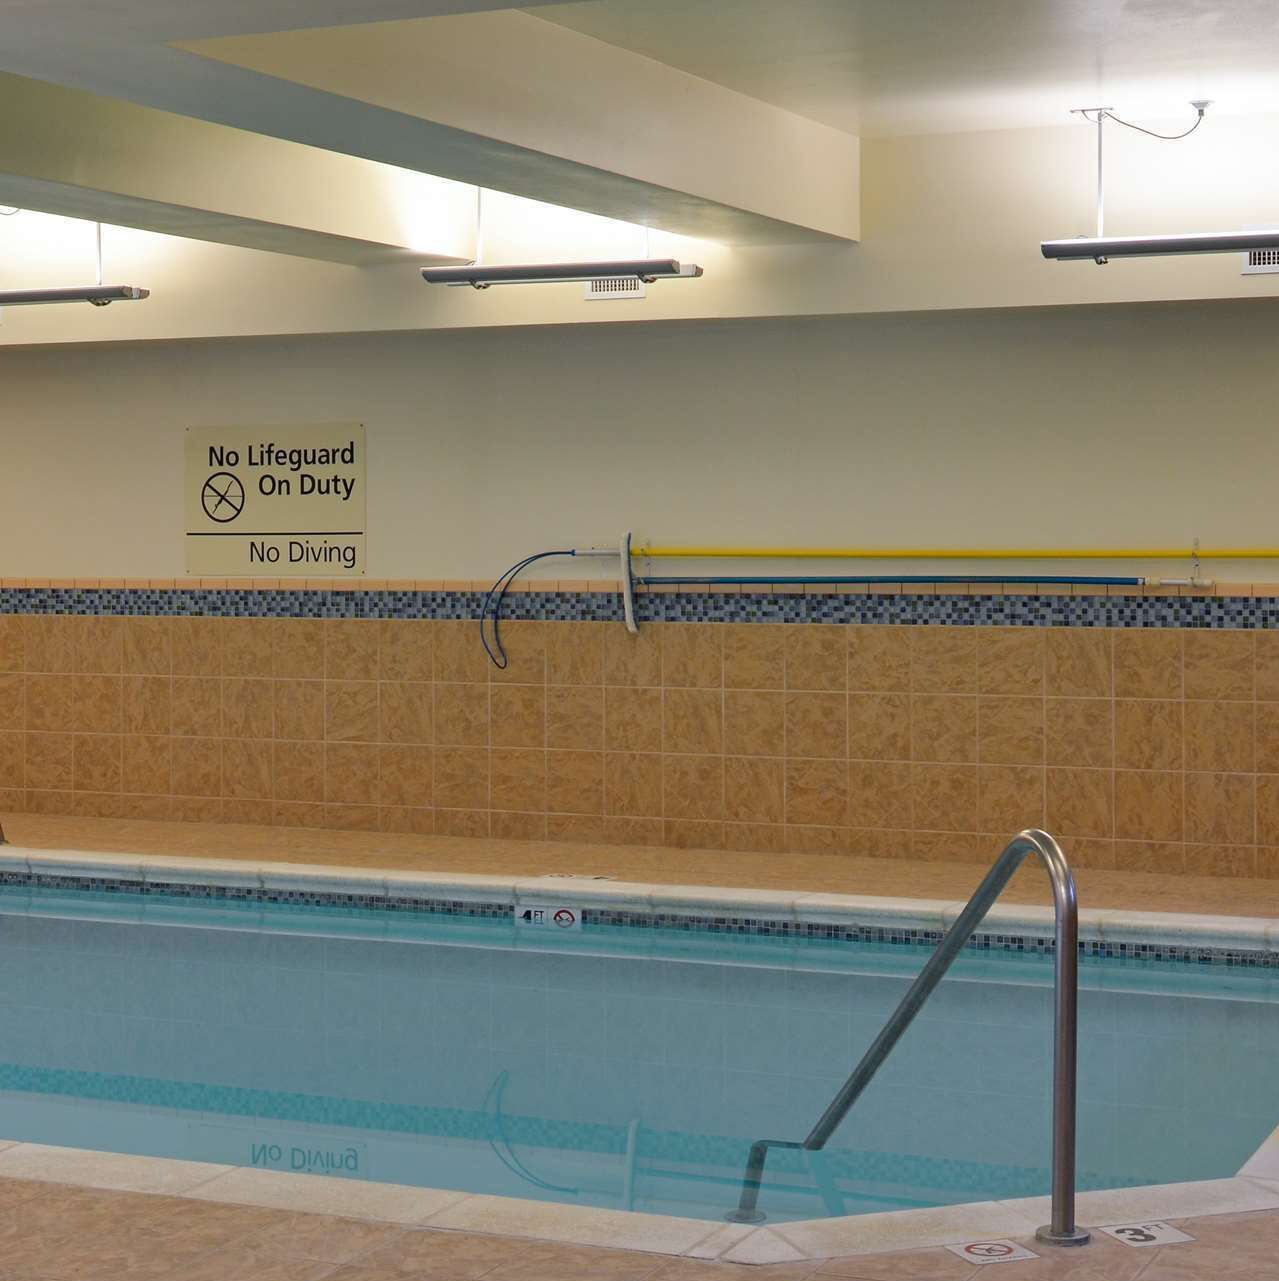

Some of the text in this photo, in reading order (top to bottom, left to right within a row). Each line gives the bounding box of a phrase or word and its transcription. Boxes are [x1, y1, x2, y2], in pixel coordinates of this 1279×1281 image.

[208, 441, 355, 472] No Lifeguard
[258, 473, 356, 501] On Duty
[250, 540, 356, 569] No Diving
[1115, 1222, 1164, 1243] 3 FT
